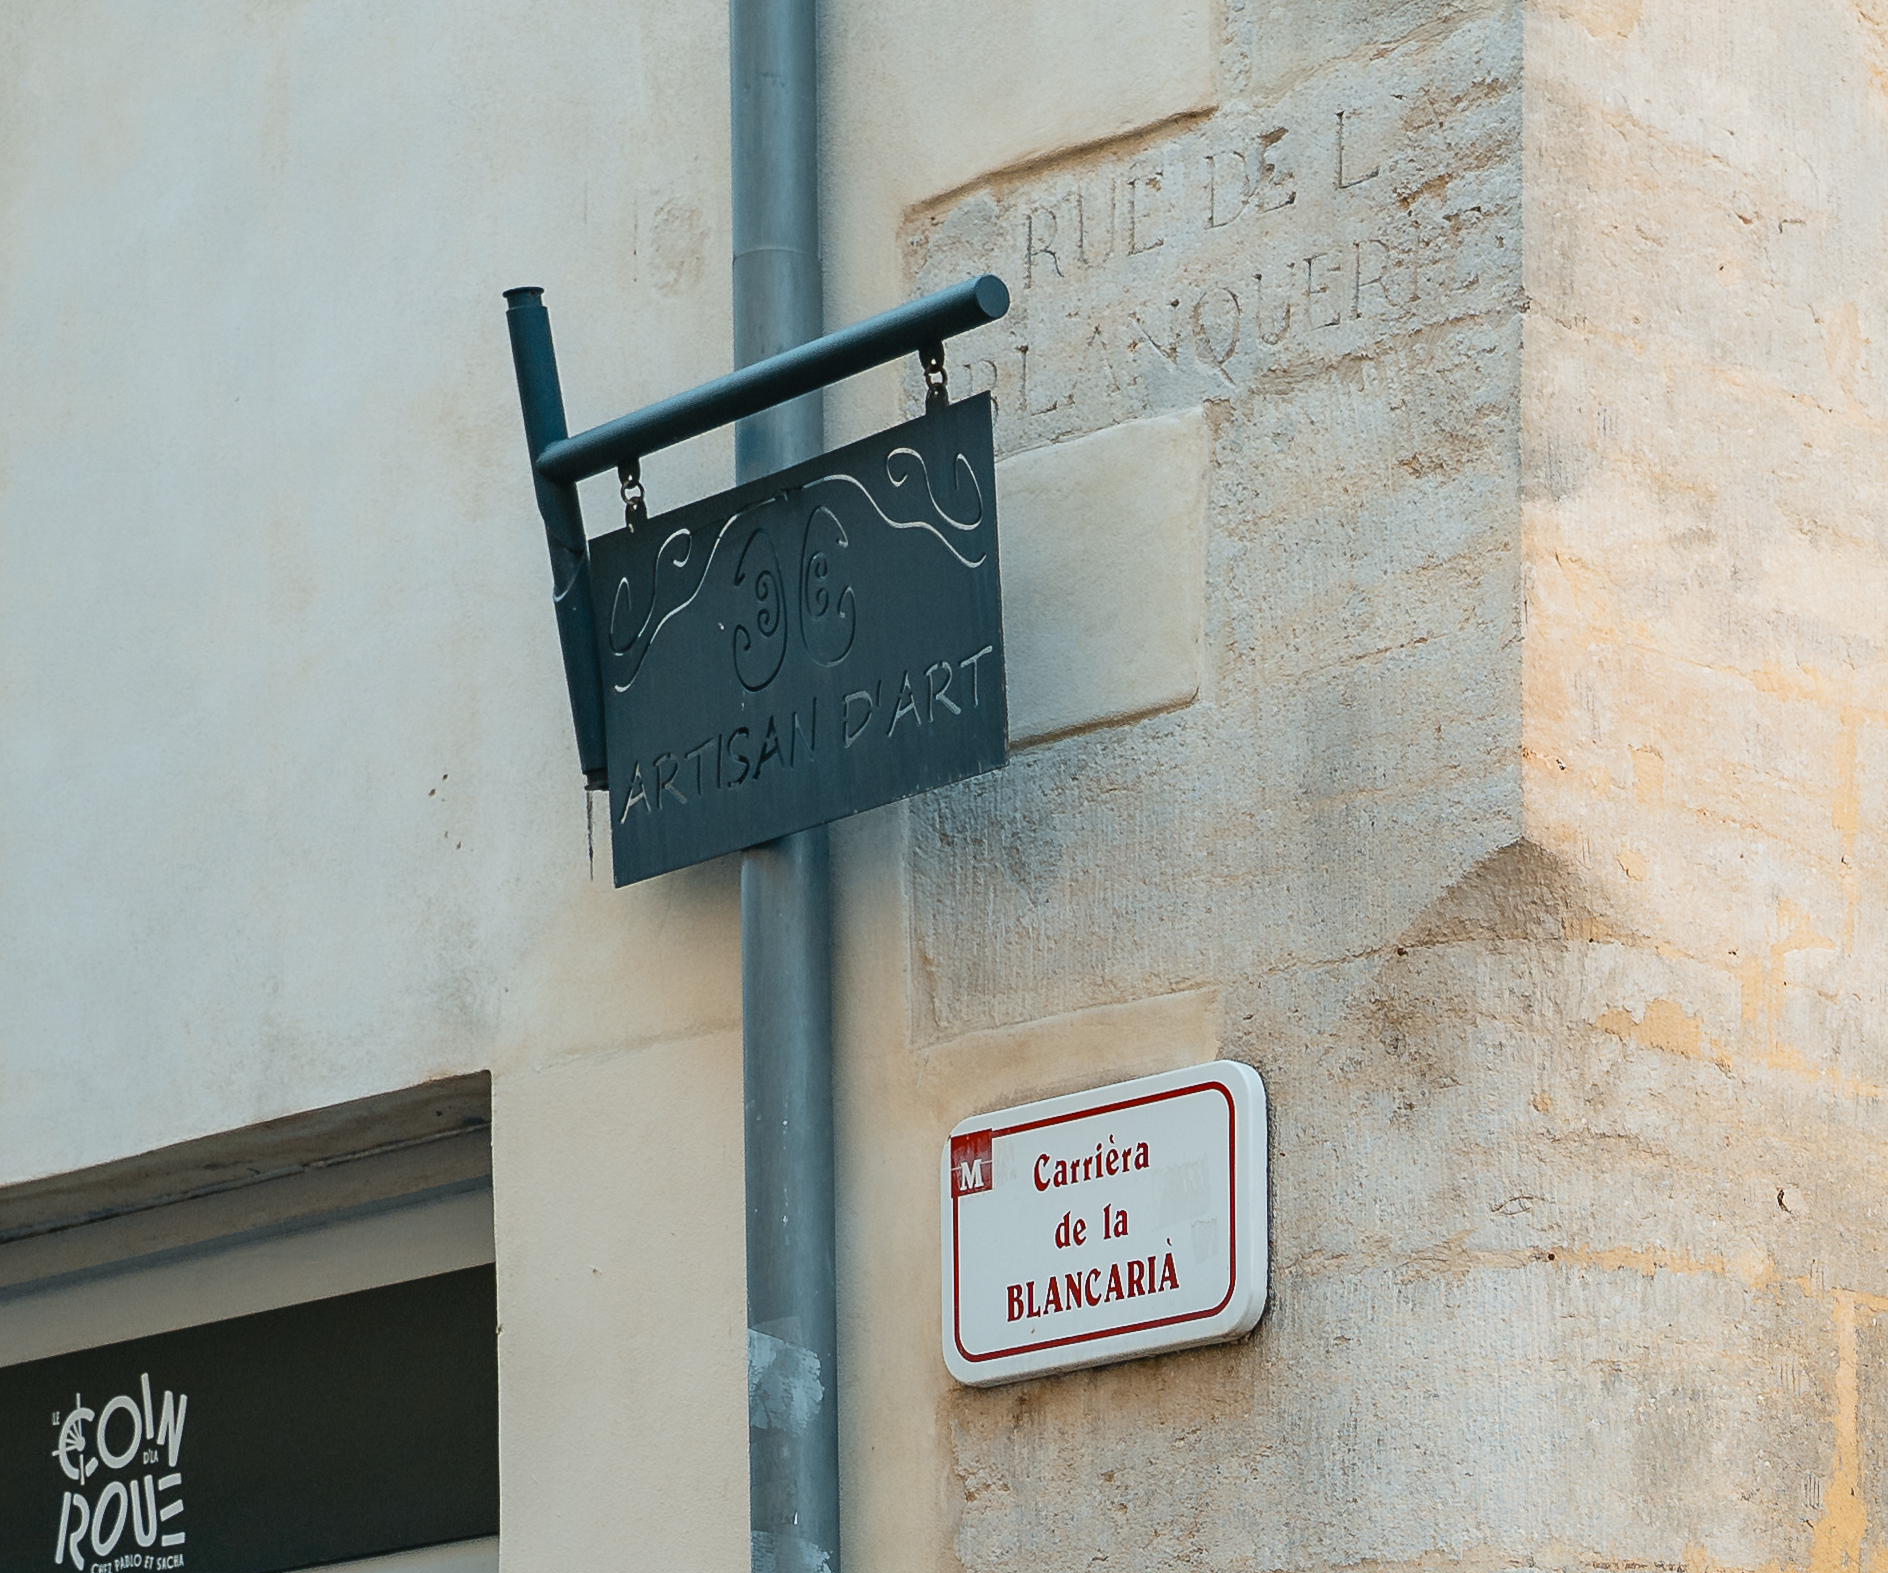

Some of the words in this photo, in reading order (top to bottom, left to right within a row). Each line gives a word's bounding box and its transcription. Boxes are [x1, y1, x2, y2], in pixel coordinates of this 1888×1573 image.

[617, 696, 819, 825] ARTISAN
[841, 644, 994, 751] D'ART
[959, 1158, 985, 1191] M
[1033, 1133, 1150, 1192] Carrièra
[1054, 1210, 1087, 1250] de
[1103, 1203, 1129, 1240] la
[1006, 1236, 1180, 1323] BLANCARIÀ
[52, 1411, 61, 1426] LE
[53, 1373, 188, 1485] COIN
[55, 1474, 186, 1571] ROUE
[114, 1554, 143, 1573] PABLO
[144, 1556, 155, 1570] ET
[156, 1553, 185, 1571] SACHA
